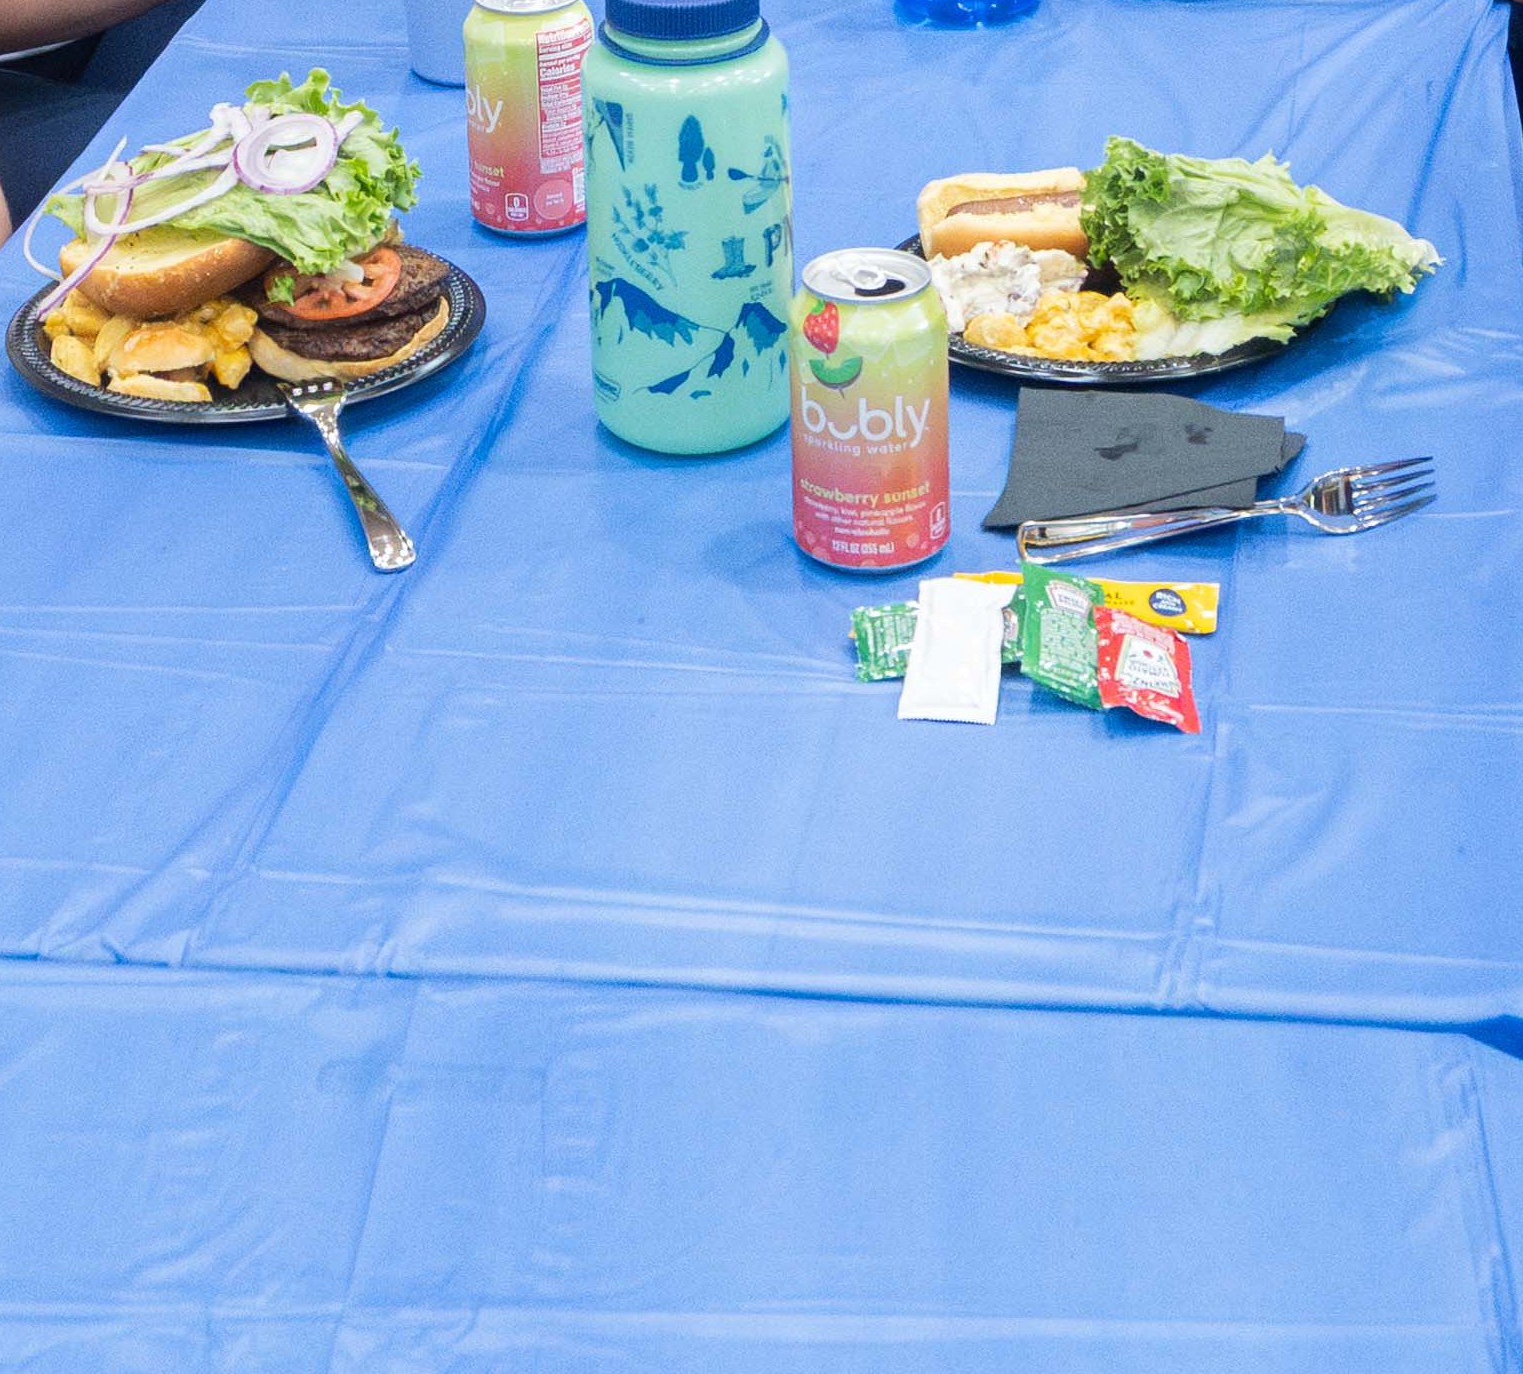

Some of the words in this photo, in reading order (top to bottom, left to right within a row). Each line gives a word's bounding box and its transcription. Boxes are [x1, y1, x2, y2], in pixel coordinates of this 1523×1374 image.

[540, 63, 576, 78] Calories
[801, 385, 931, 449] bubly
[803, 433, 861, 457] sparkling
[866, 441, 909, 455] water
[800, 478, 879, 508] strawberry
[884, 481, 931, 504] sunset
